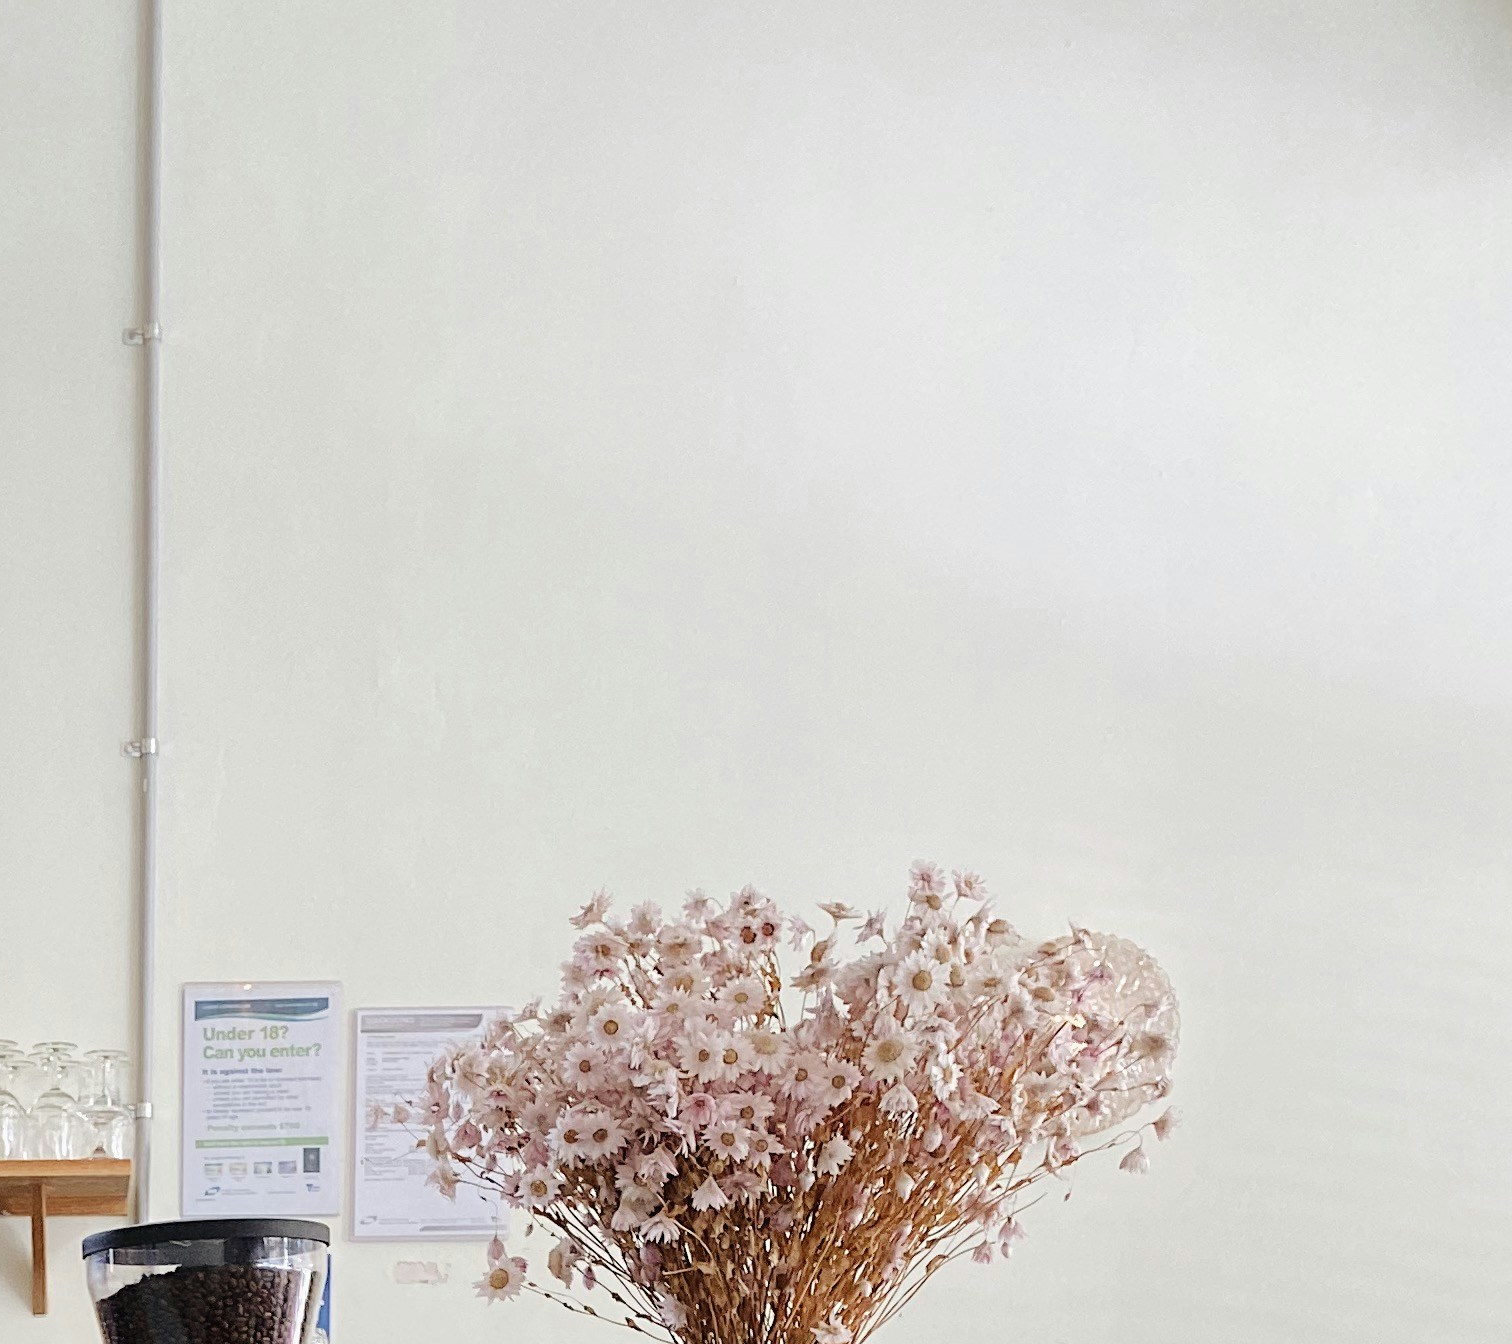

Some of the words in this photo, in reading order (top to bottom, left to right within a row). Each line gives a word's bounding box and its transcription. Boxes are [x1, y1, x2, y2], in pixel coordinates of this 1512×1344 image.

[203, 1026, 255, 1041] Under
[260, 1025, 289, 1040] 18?
[203, 1045, 234, 1059] Can
[237, 1047, 266, 1062] you
[269, 1043, 322, 1058] enter?
